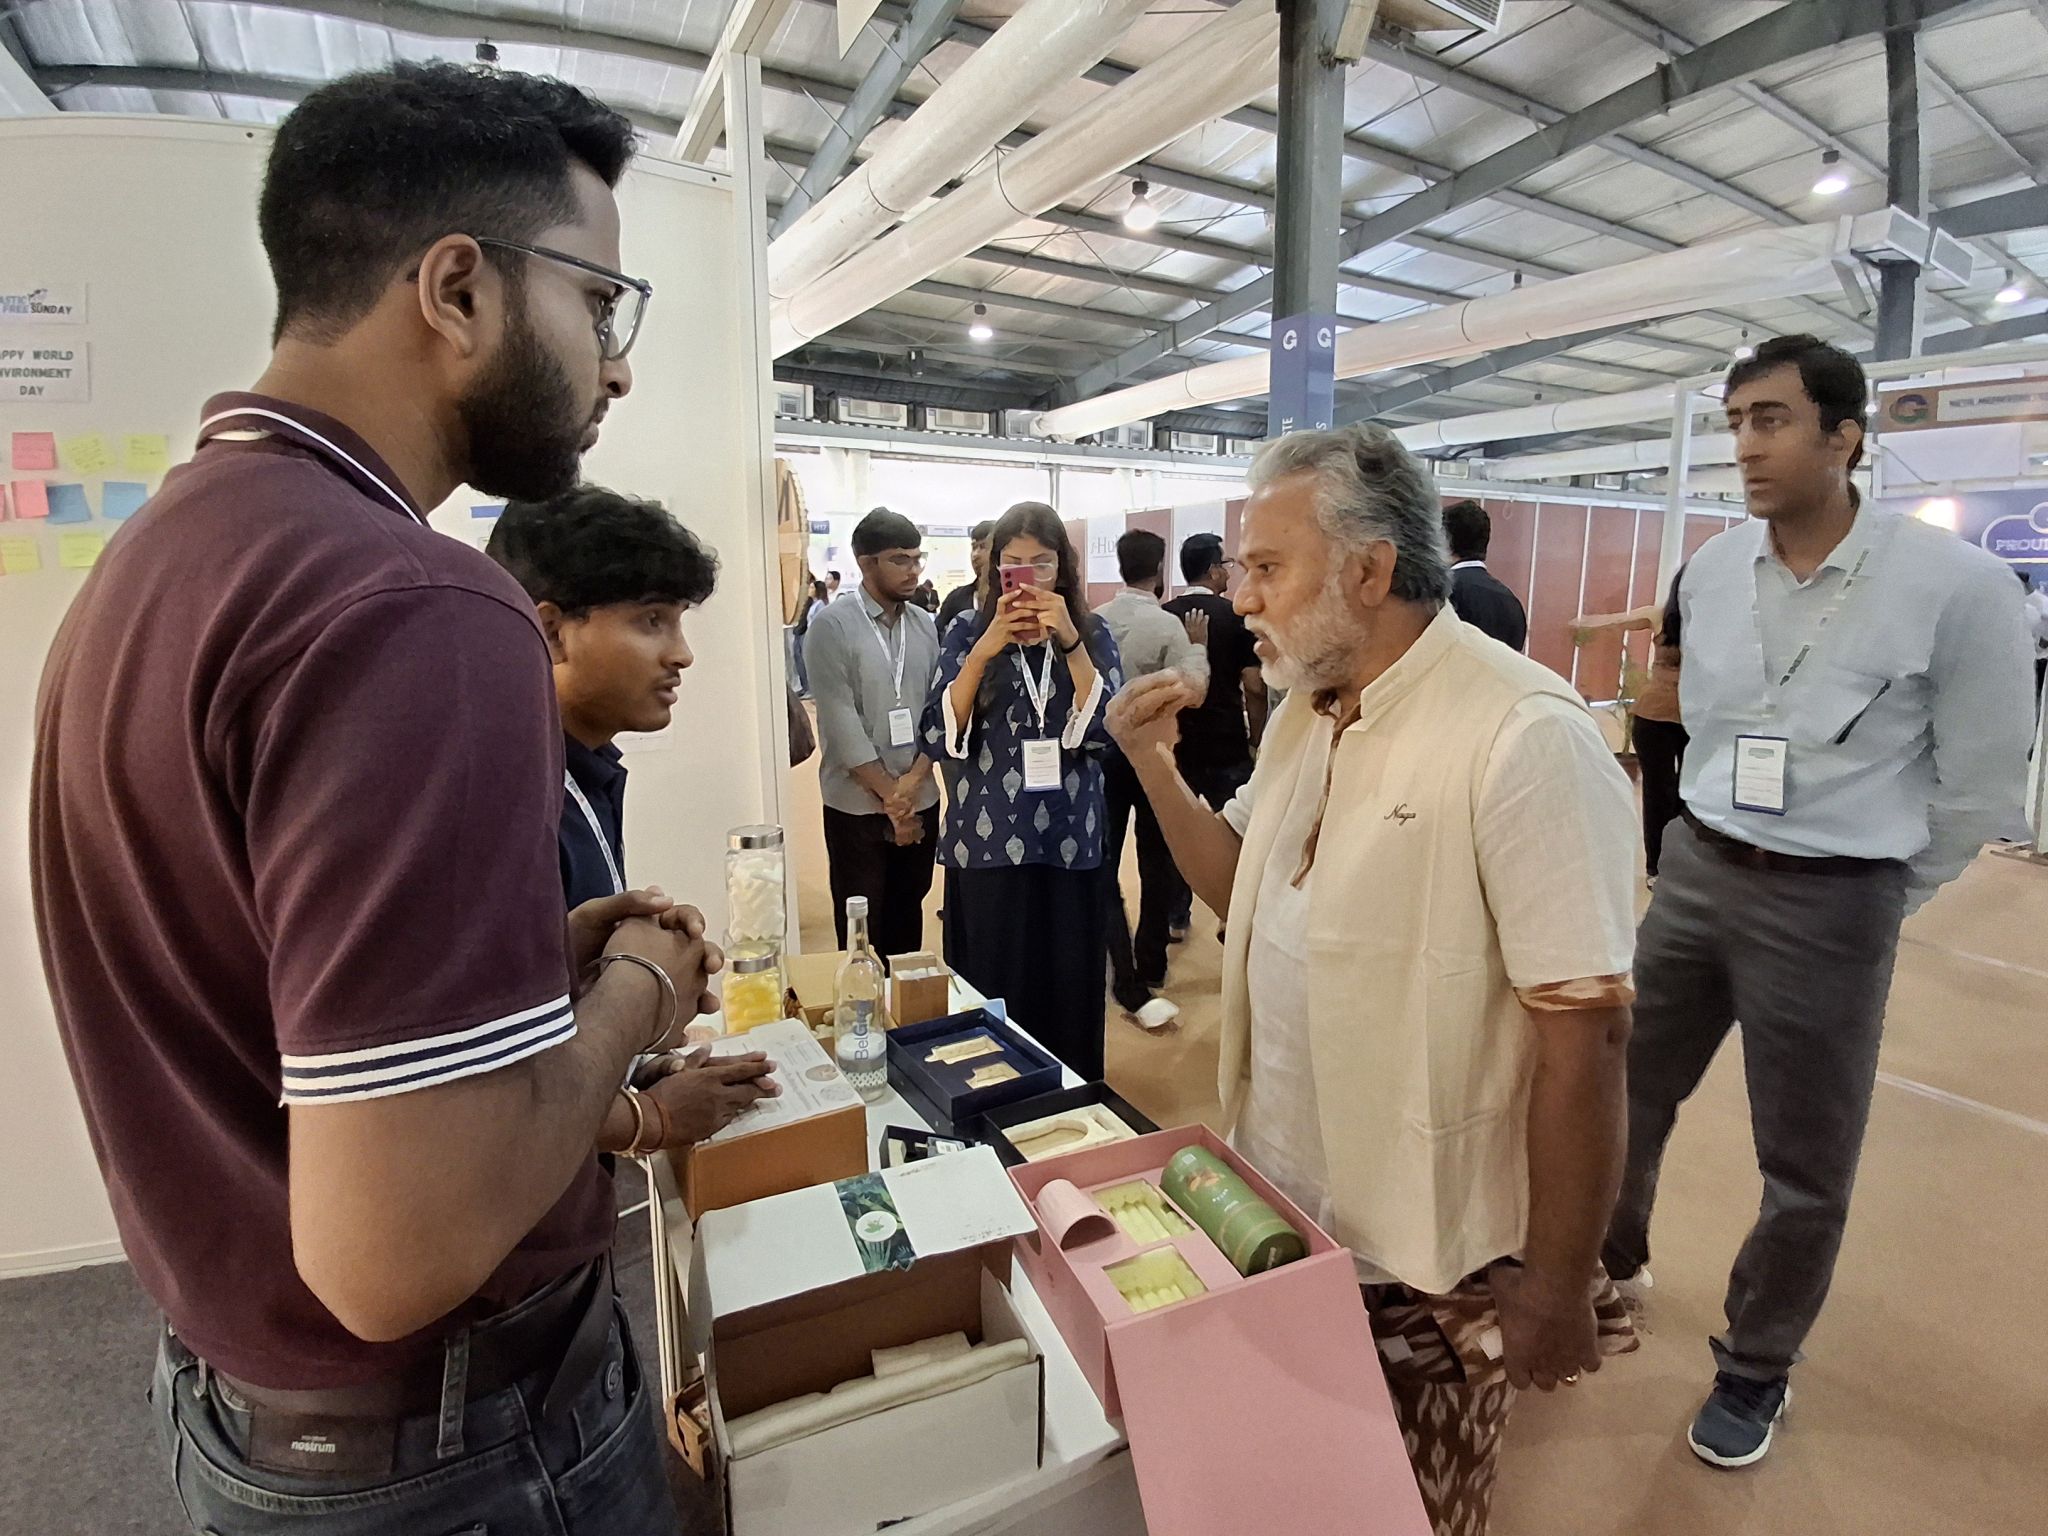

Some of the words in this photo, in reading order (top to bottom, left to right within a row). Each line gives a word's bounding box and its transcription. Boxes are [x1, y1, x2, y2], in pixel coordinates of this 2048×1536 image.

[31, 303, 72, 314] SUNDAY
[0, 350, 24, 360] PPY
[33, 350, 74, 360] WORLD
[20, 385, 44, 395] DAY
[291, 1441, 336, 1452] nostrum
